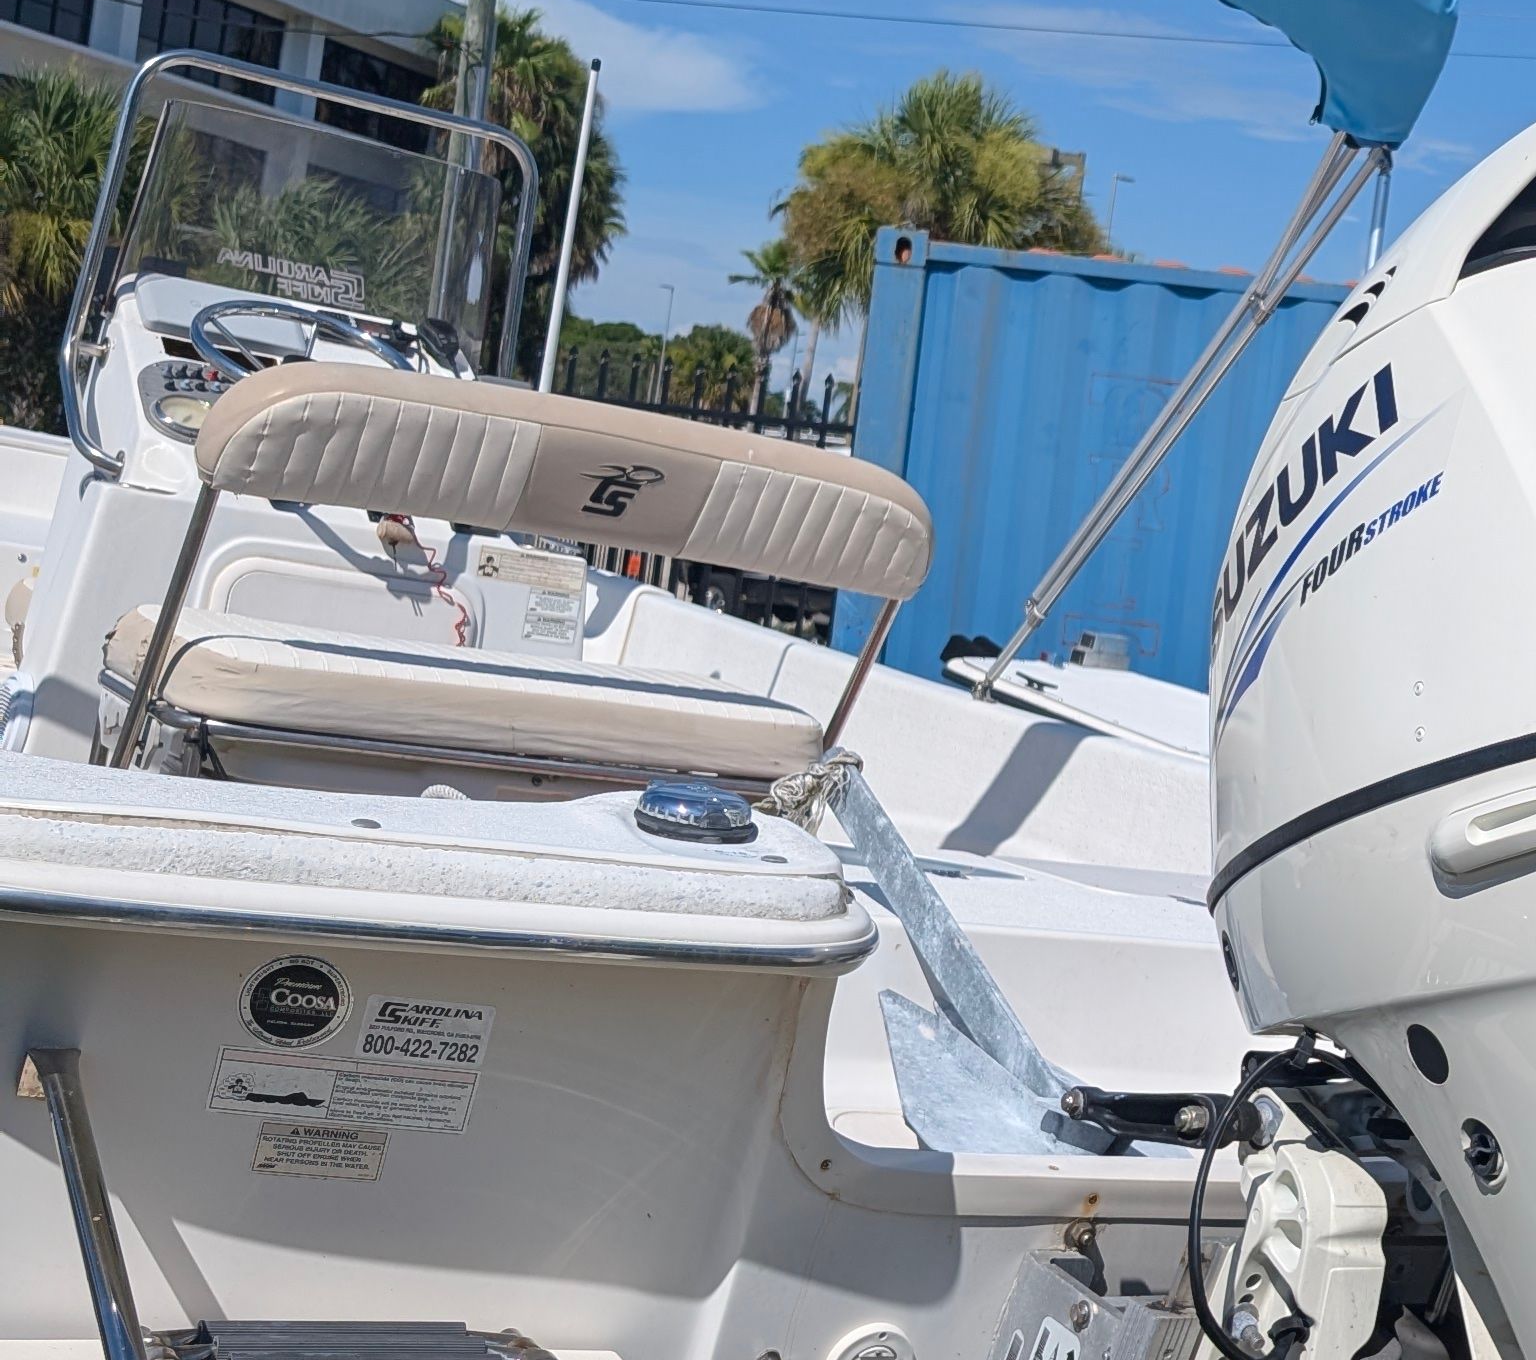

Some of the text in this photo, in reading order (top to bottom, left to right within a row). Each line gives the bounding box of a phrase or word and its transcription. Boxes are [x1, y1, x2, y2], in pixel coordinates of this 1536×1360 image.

[1300, 471, 1444, 608] FOURSTROKE
[378, 1001, 483, 1021] CAROLINA
[362, 1034, 479, 1064] 800-422-7282
[263, 1136, 297, 1144] ROTATING
[304, 1127, 359, 1140] WARNING
